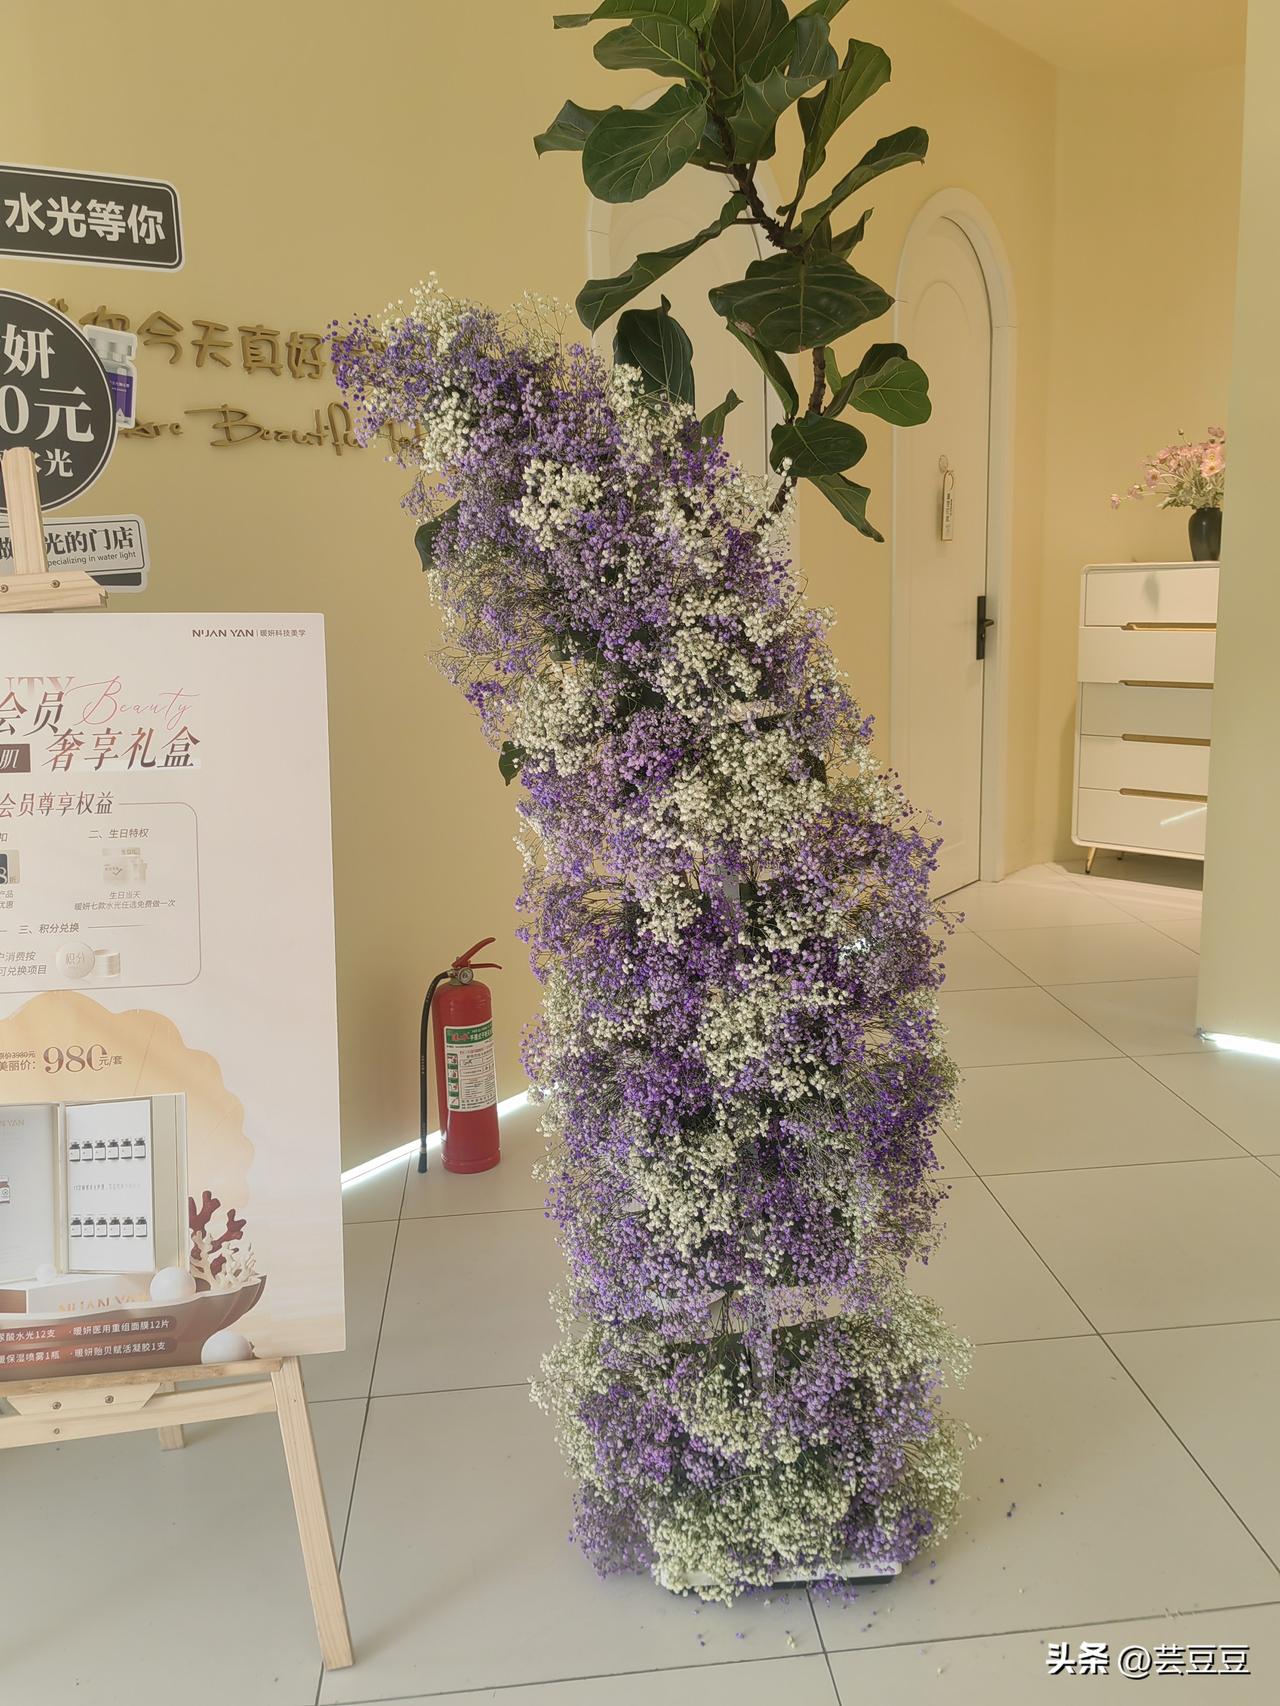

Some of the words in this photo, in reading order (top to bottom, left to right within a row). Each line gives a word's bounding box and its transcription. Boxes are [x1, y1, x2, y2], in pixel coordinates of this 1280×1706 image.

[4, 191, 166, 245] 水光等你
[2, 322, 56, 379] 妍
[97, 553, 118, 561] water
[119, 551, 137, 561] light
[229, 629, 254, 638] YAN
[65, 675, 201, 731] Beauty
[41, 725, 201, 773] 奢享礼盒
[0, 790, 114, 818] 会员尊享权益
[88, 828, 150, 840] 二、生日特权
[108, 890, 142, 900] 生日当天
[18, 922, 80, 935] 三、积分兑换
